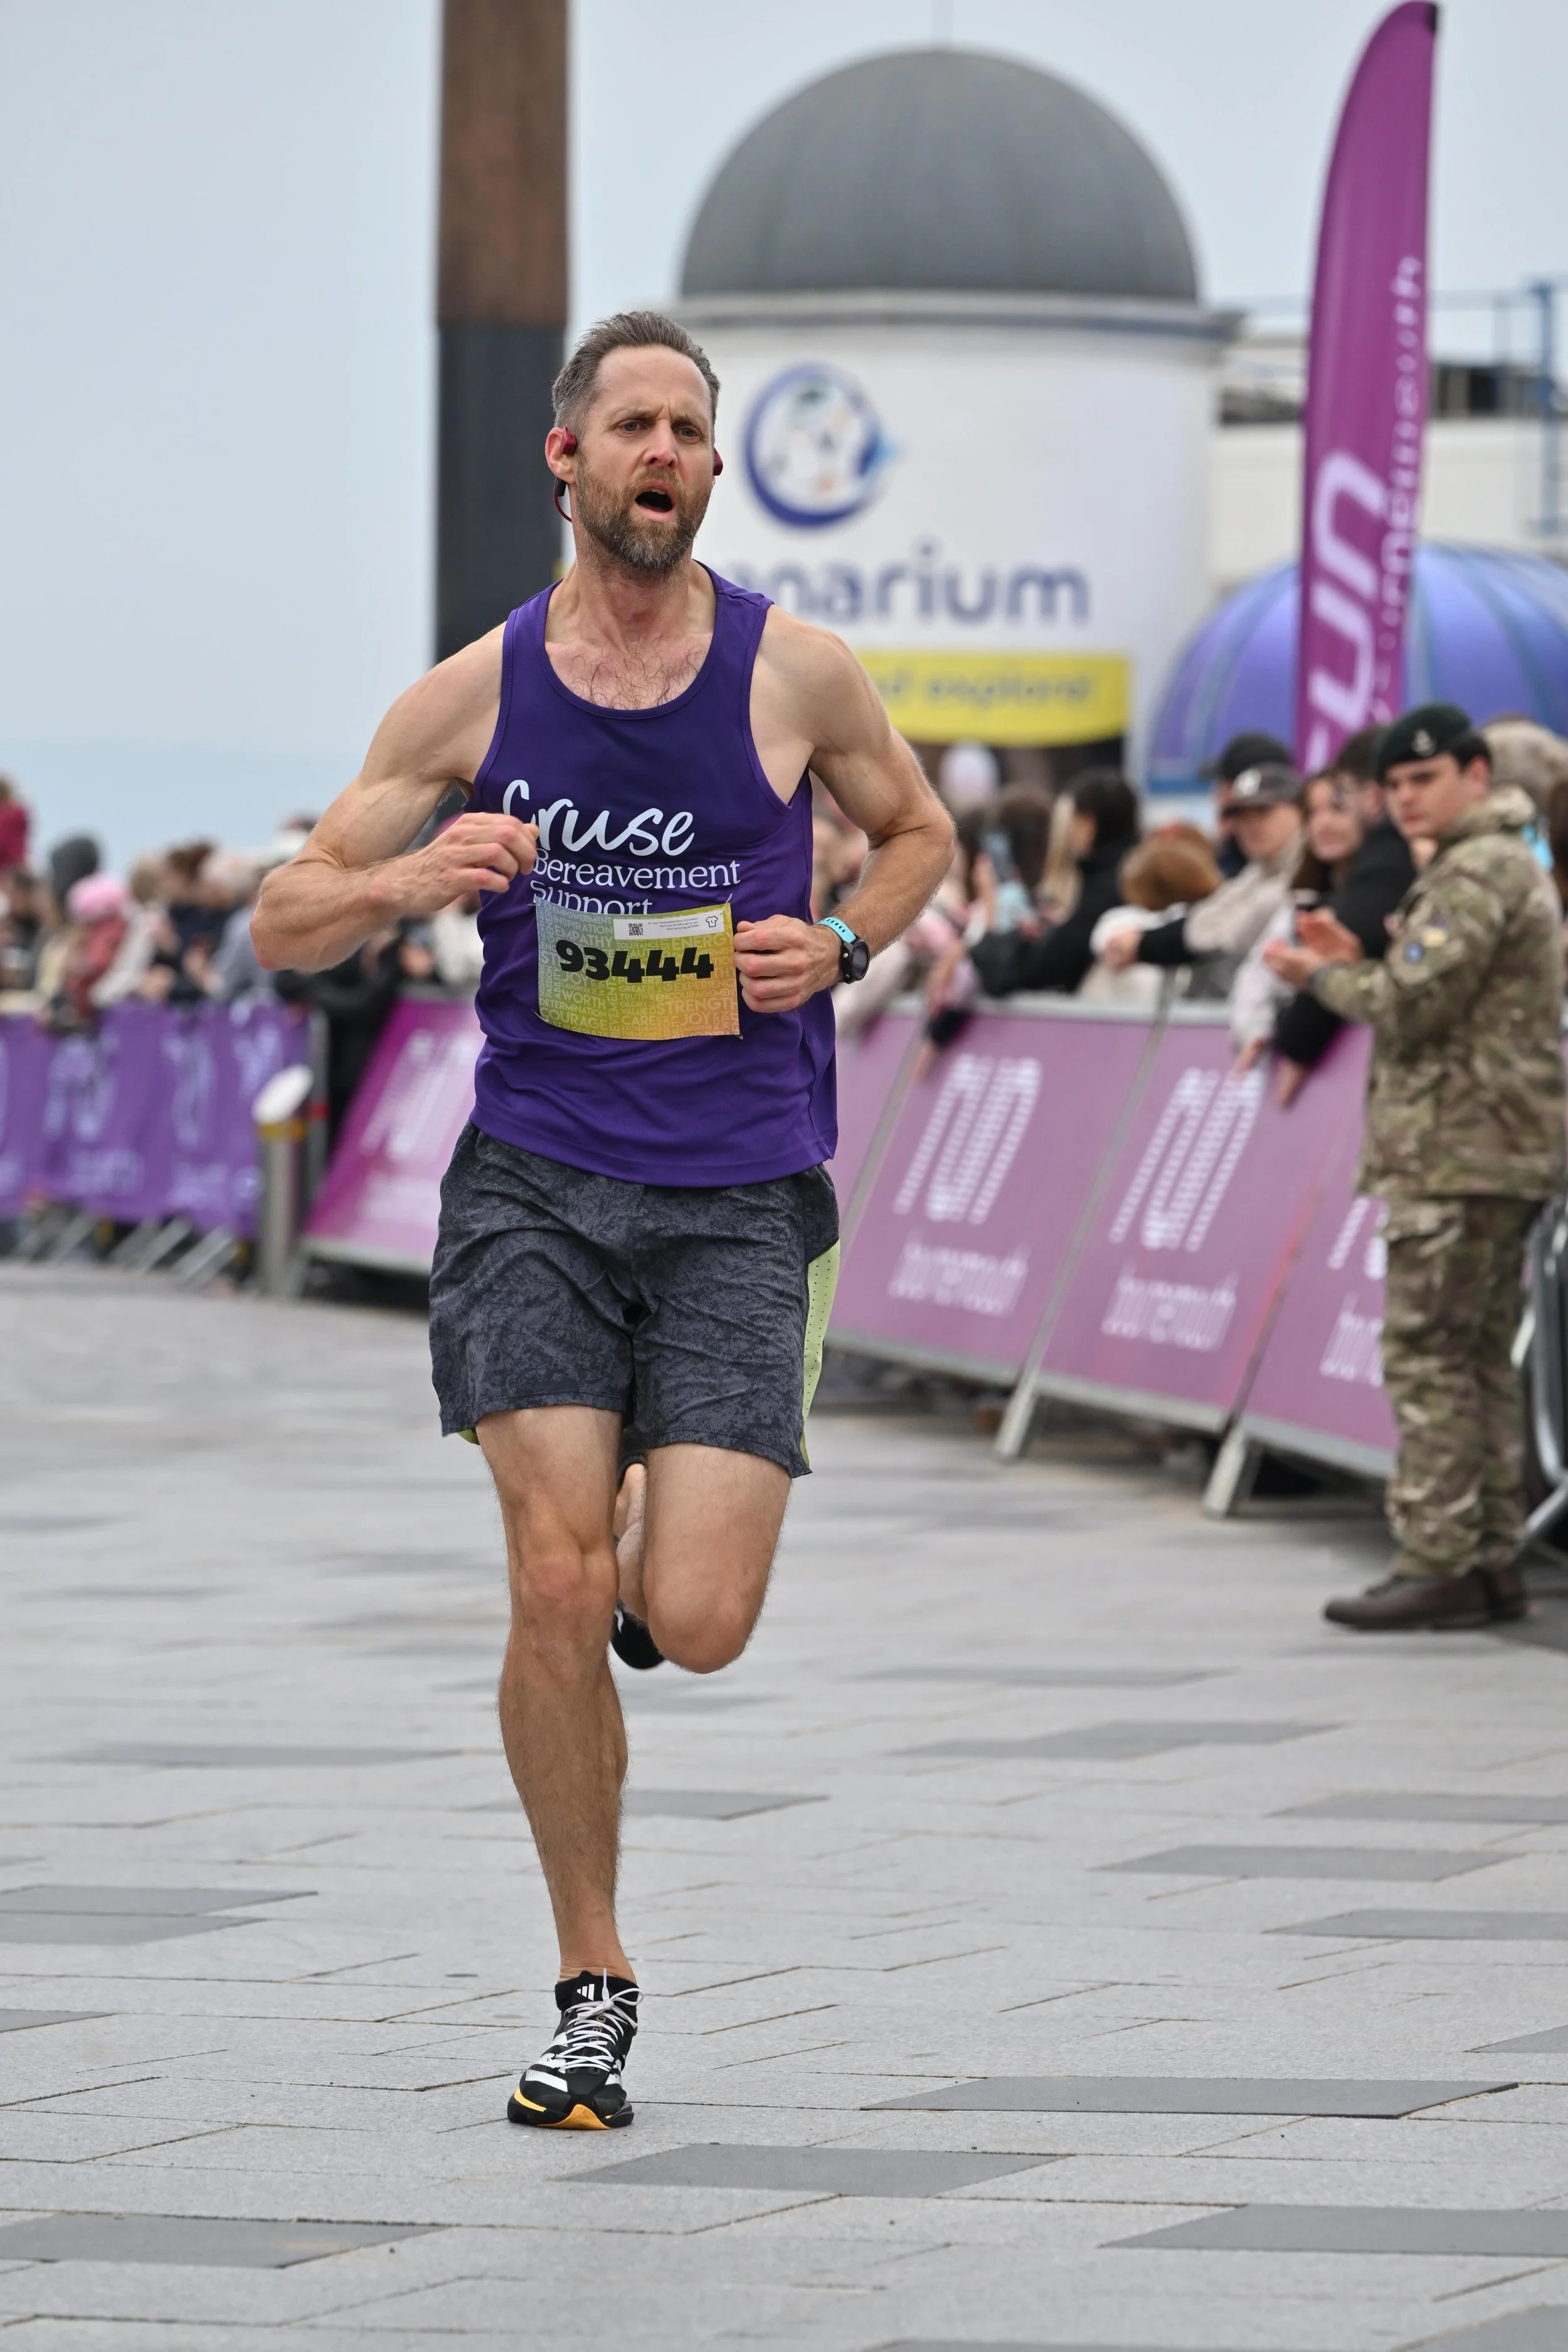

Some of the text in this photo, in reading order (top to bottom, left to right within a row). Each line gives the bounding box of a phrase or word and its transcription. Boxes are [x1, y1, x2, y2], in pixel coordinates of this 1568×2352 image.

[502, 779, 695, 856] Cruse
[533, 847, 741, 889] Bereavement
[553, 906, 613, 924] EMPOWERMENT
[553, 914, 613, 935] INSPIRATION
[554, 924, 613, 948] EMPATHY
[556, 940, 714, 983] 93444
[561, 988, 606, 1010] WORTH
[618, 985, 647, 993] GREAT
[539, 998, 607, 1019] DETERMINATION
[540, 1007, 608, 1030] COURAGE
[620, 1007, 648, 1015] VALUE
[680, 1011, 711, 1026] JOY
[622, 1015, 657, 1026] CARE
